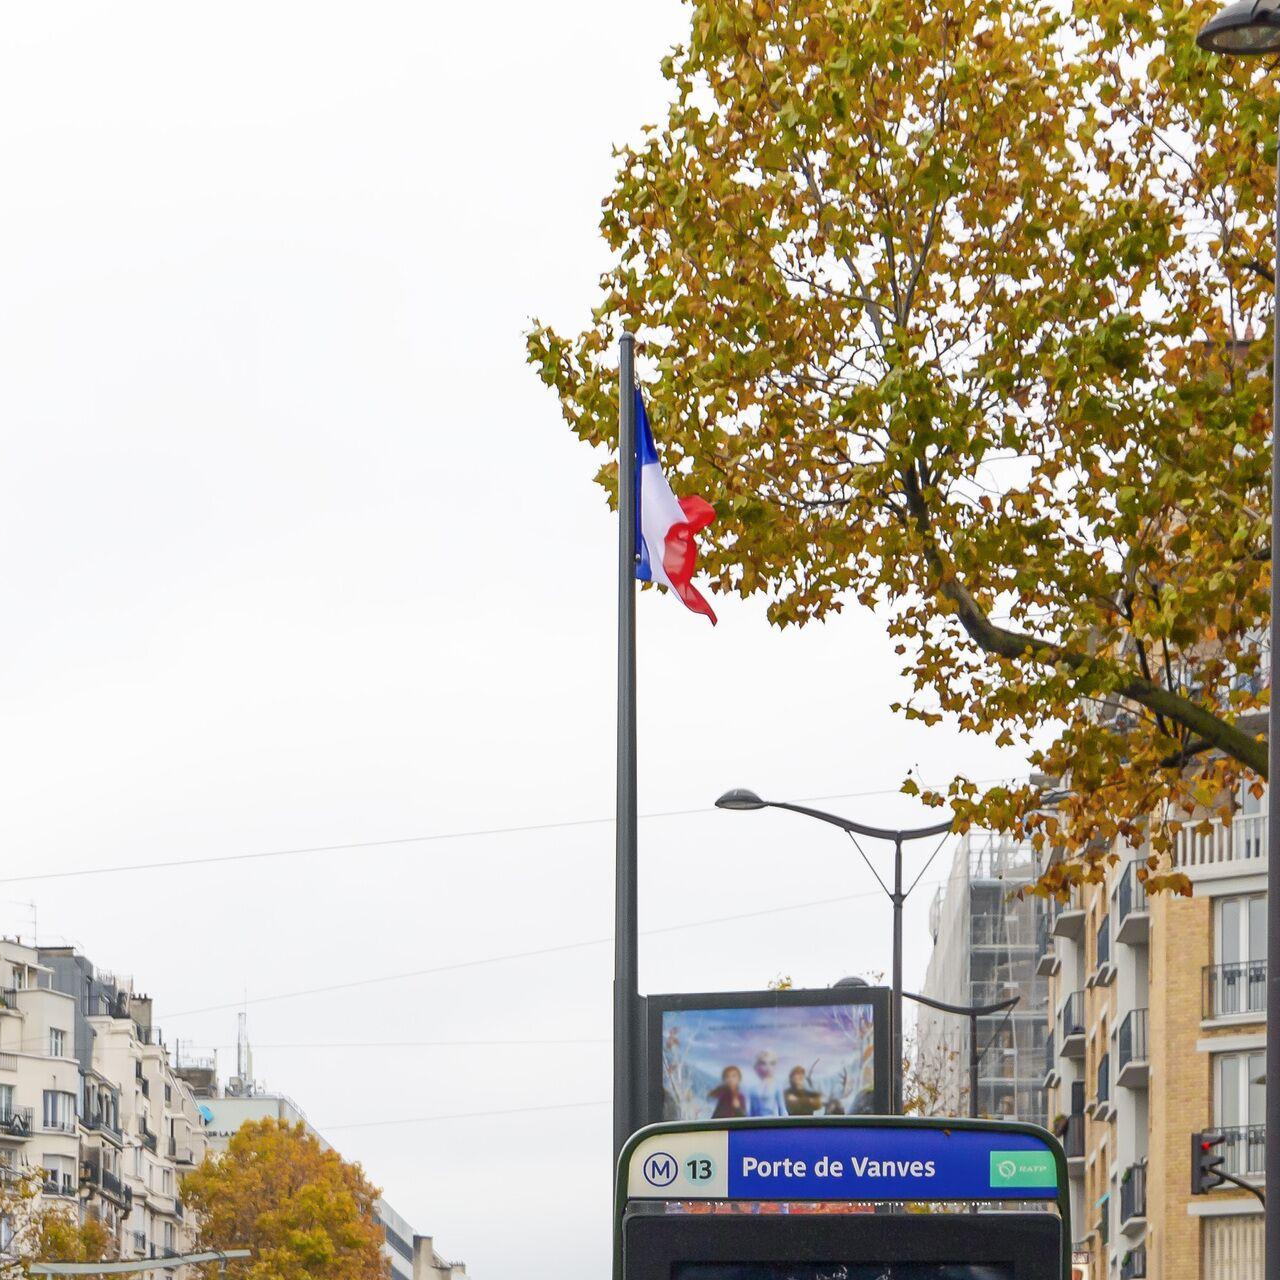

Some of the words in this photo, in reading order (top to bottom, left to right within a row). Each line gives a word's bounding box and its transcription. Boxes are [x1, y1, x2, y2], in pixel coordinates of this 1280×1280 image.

[686, 1159, 713, 1180] 13
[742, 1156, 807, 1178] Porte
[814, 1155, 844, 1178] de
[850, 1156, 936, 1178] Vanves
[1018, 1164, 1048, 1174] RATP
